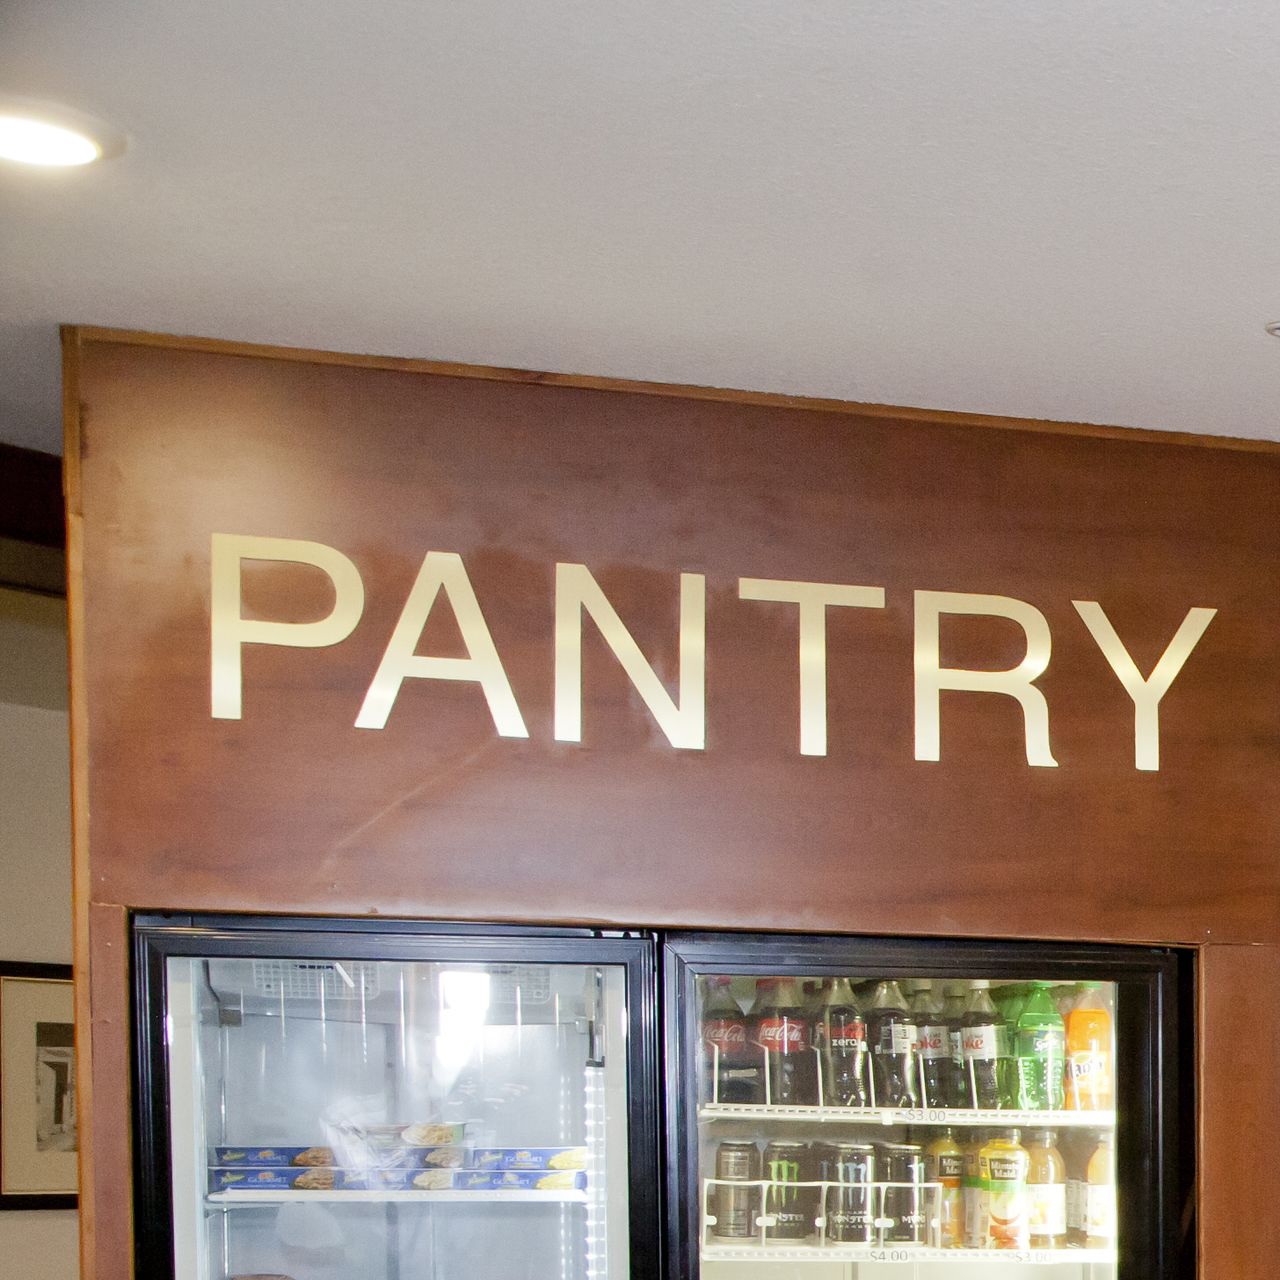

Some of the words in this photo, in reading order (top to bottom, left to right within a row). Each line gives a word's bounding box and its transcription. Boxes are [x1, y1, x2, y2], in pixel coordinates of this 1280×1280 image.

[211, 532, 1217, 771] PANTRY
[908, 1111, 946, 1122] $3.00
[870, 1250, 909, 1261] $4.00
